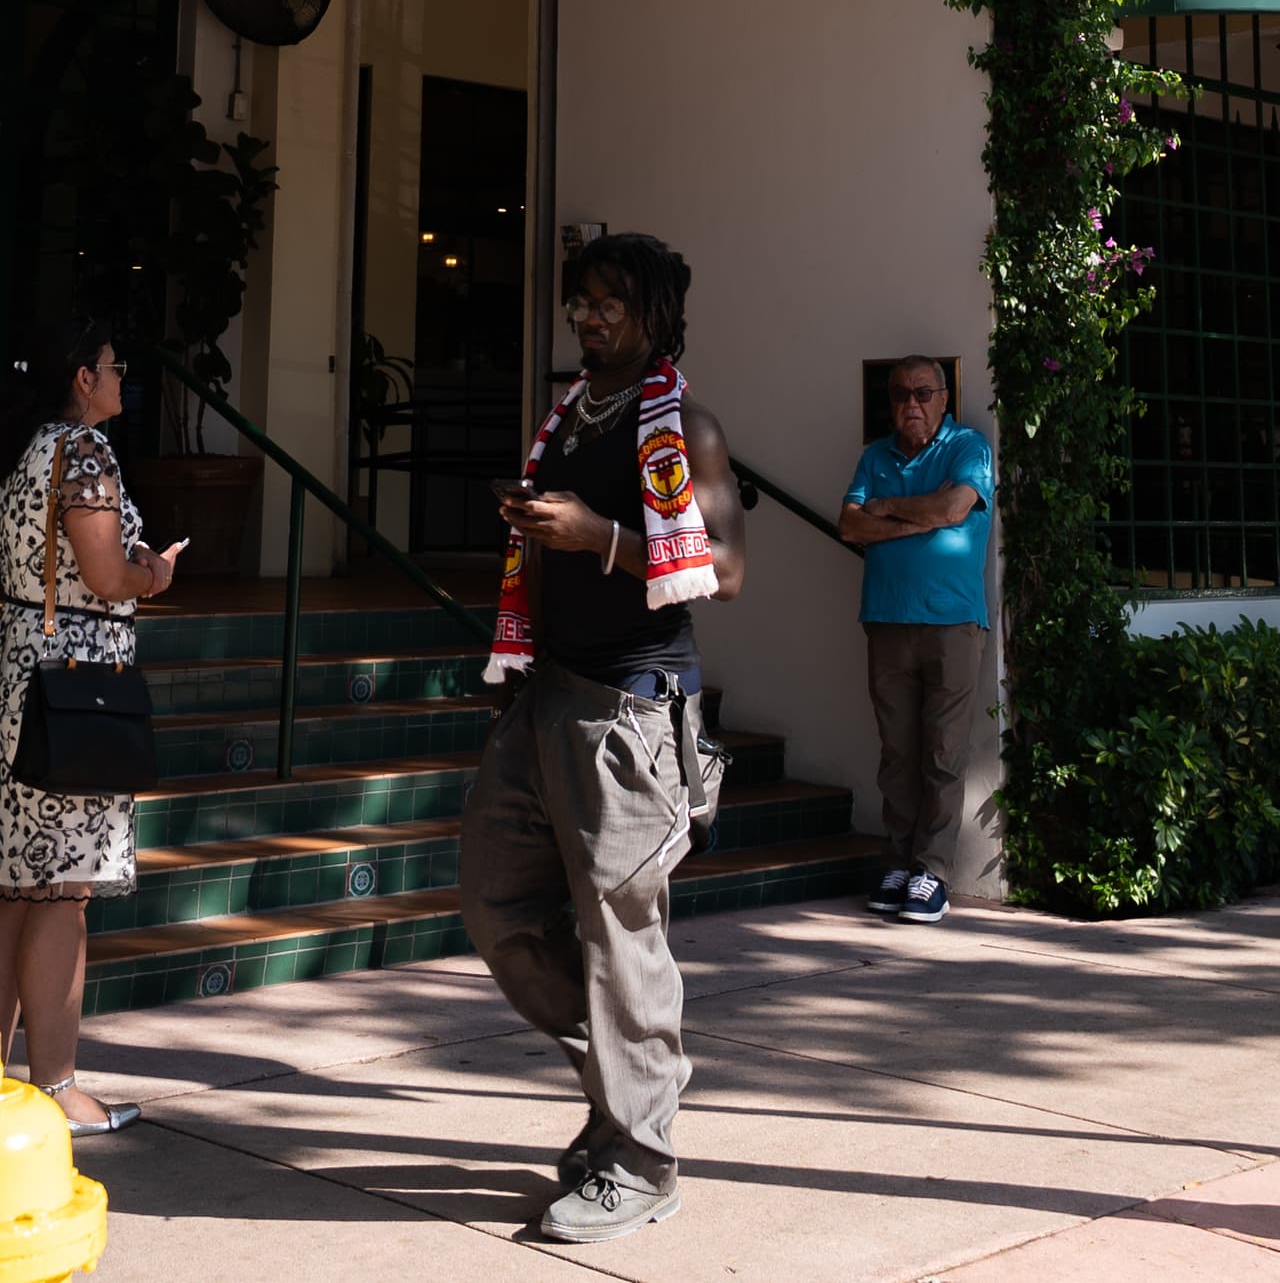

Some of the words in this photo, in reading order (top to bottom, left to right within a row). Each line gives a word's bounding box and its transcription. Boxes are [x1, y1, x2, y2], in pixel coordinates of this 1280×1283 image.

[638, 432, 686, 464] FOREVER
[653, 490, 691, 511] UNITED
[648, 533, 706, 565] UNITED
